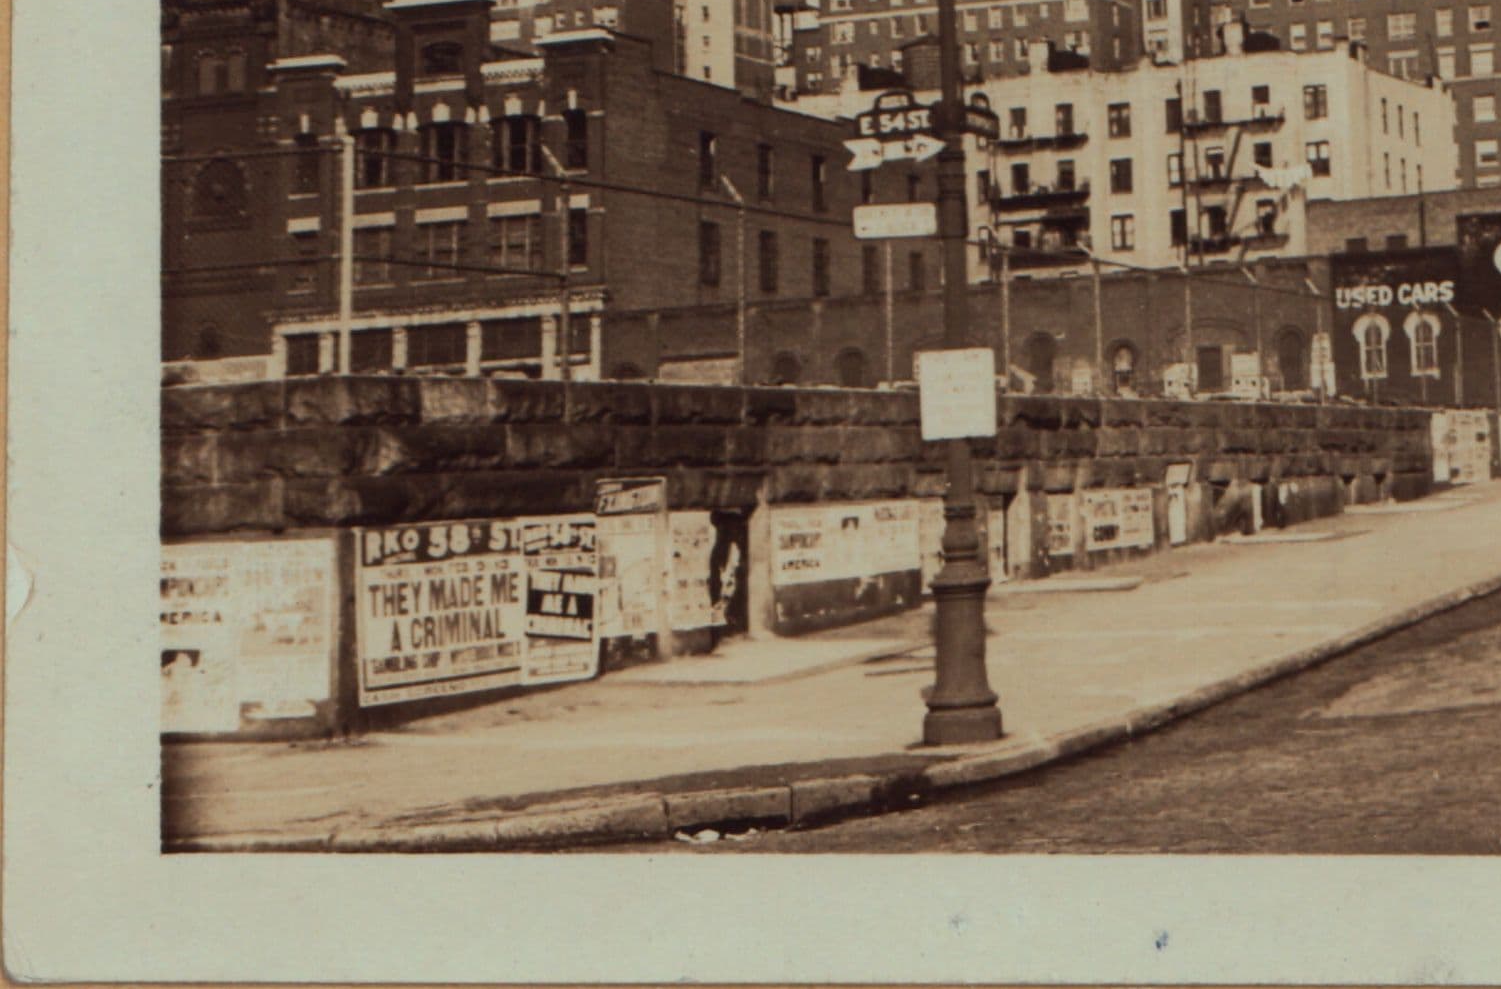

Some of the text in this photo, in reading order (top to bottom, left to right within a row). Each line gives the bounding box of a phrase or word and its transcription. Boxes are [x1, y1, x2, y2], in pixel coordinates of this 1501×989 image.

[1335, 280, 1455, 309] USED CARS
[364, 529, 420, 564] RKO
[369, 580, 421, 618] THEY
[429, 574, 484, 610] MADE
[490, 572, 519, 605] ME
[391, 620, 402, 652] A
[411, 608, 506, 649] CRIMINAL
